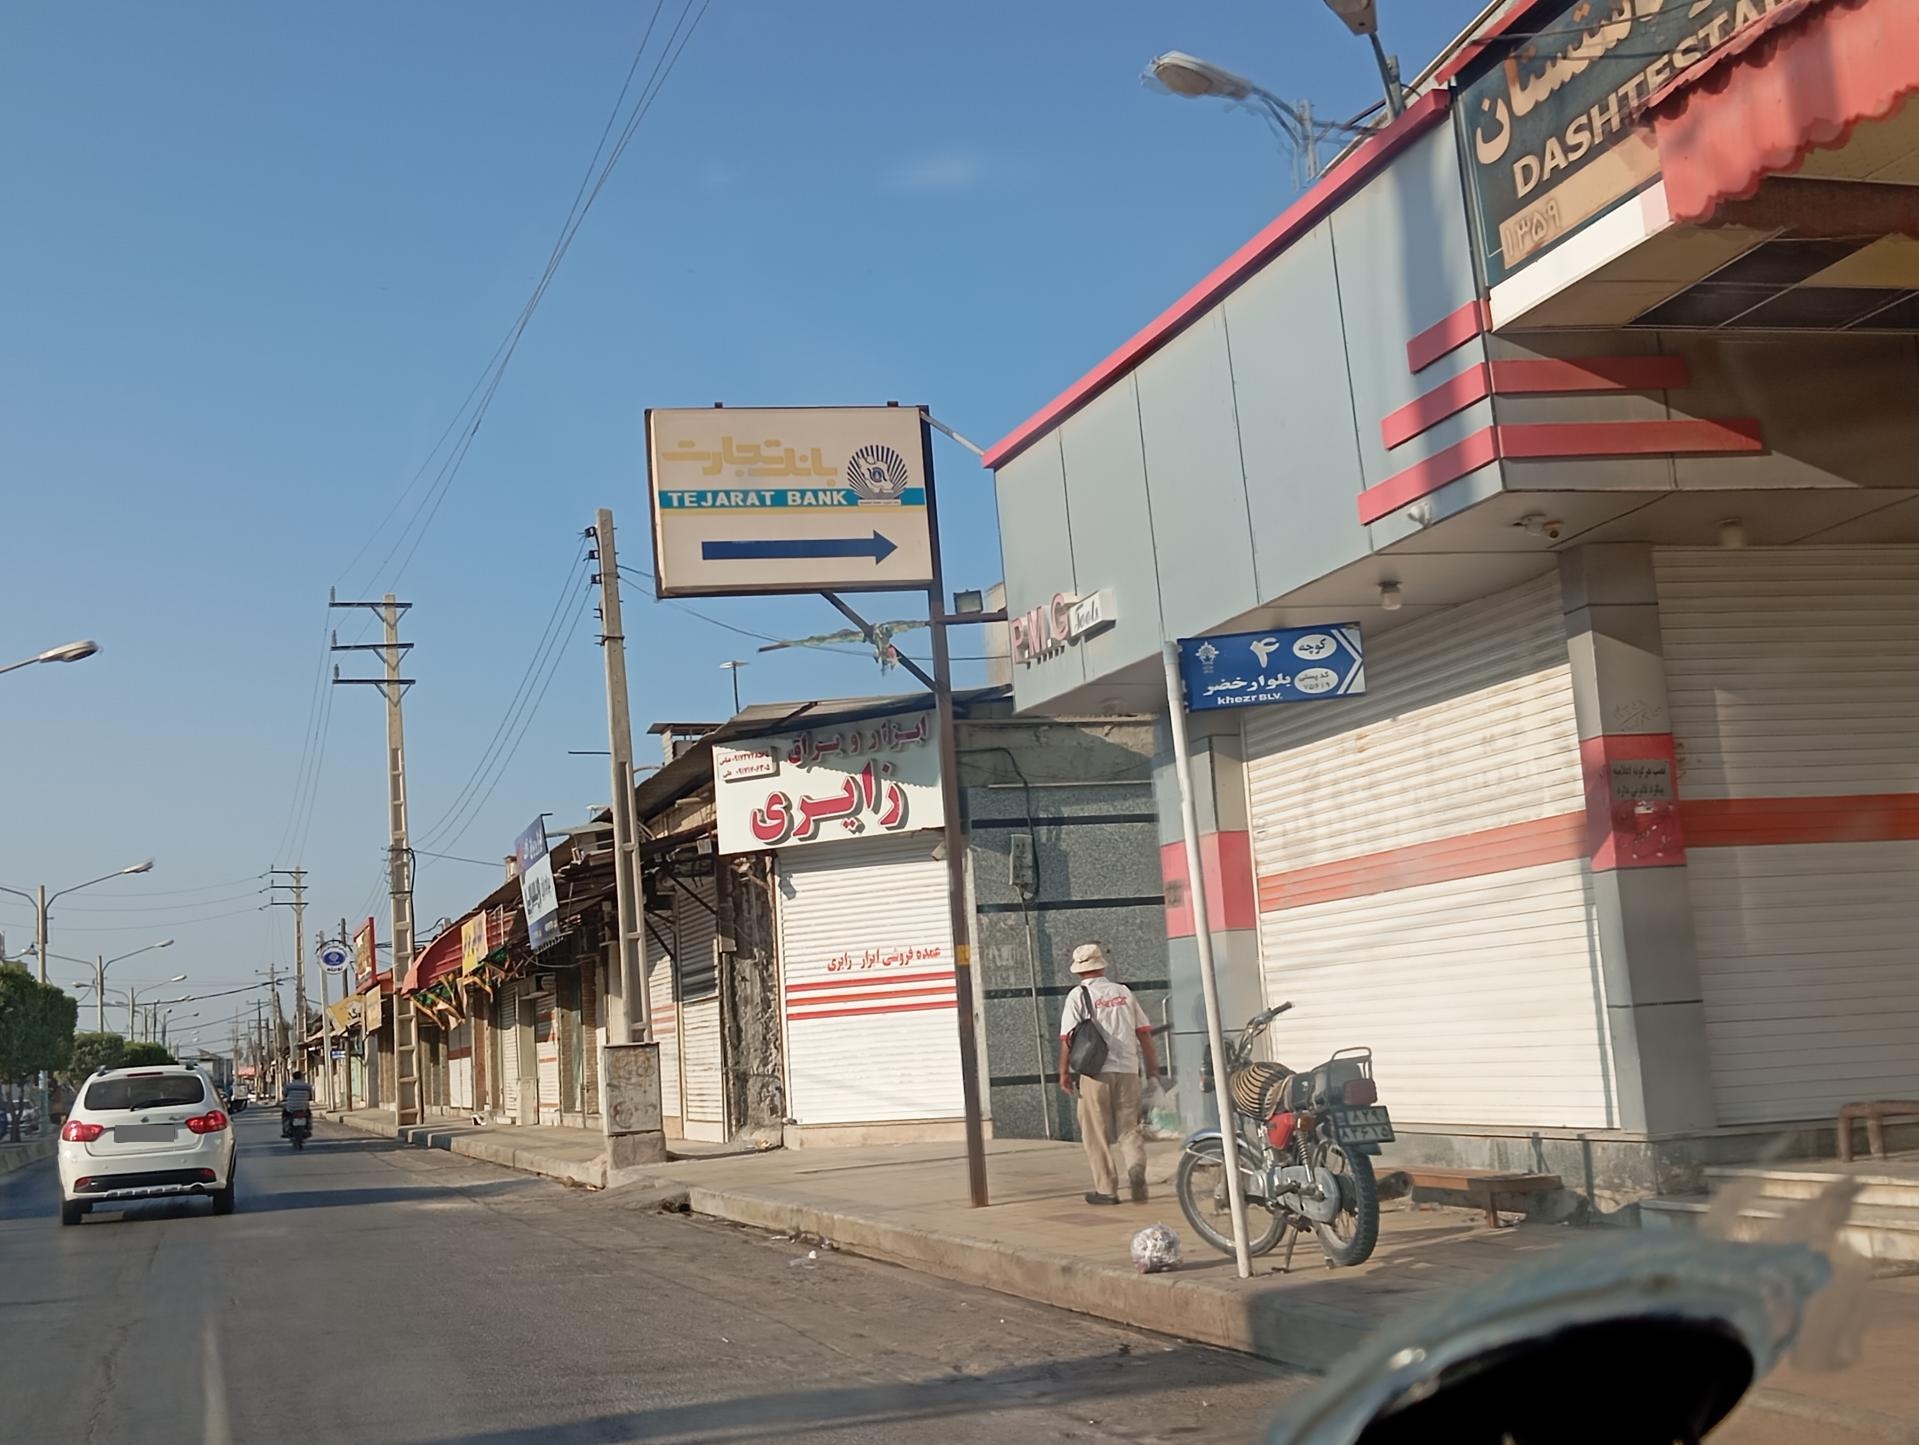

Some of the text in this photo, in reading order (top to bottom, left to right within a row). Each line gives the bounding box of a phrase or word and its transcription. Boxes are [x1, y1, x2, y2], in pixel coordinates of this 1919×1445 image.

[1513, 0, 1778, 199] DASHTESTA
[668, 490, 848, 508] TEJARAT BANK
[1250, 637, 1280, 668] ۴
[1298, 638, 1327, 655] کوچه
[1202, 672, 1292, 696] بلوار خضر
[1217, 694, 1257, 705] khezr
[787, 713, 929, 765] ابزار و یراق
[751, 760, 904, 842] زایری
[915, 946, 941, 960] عمده
